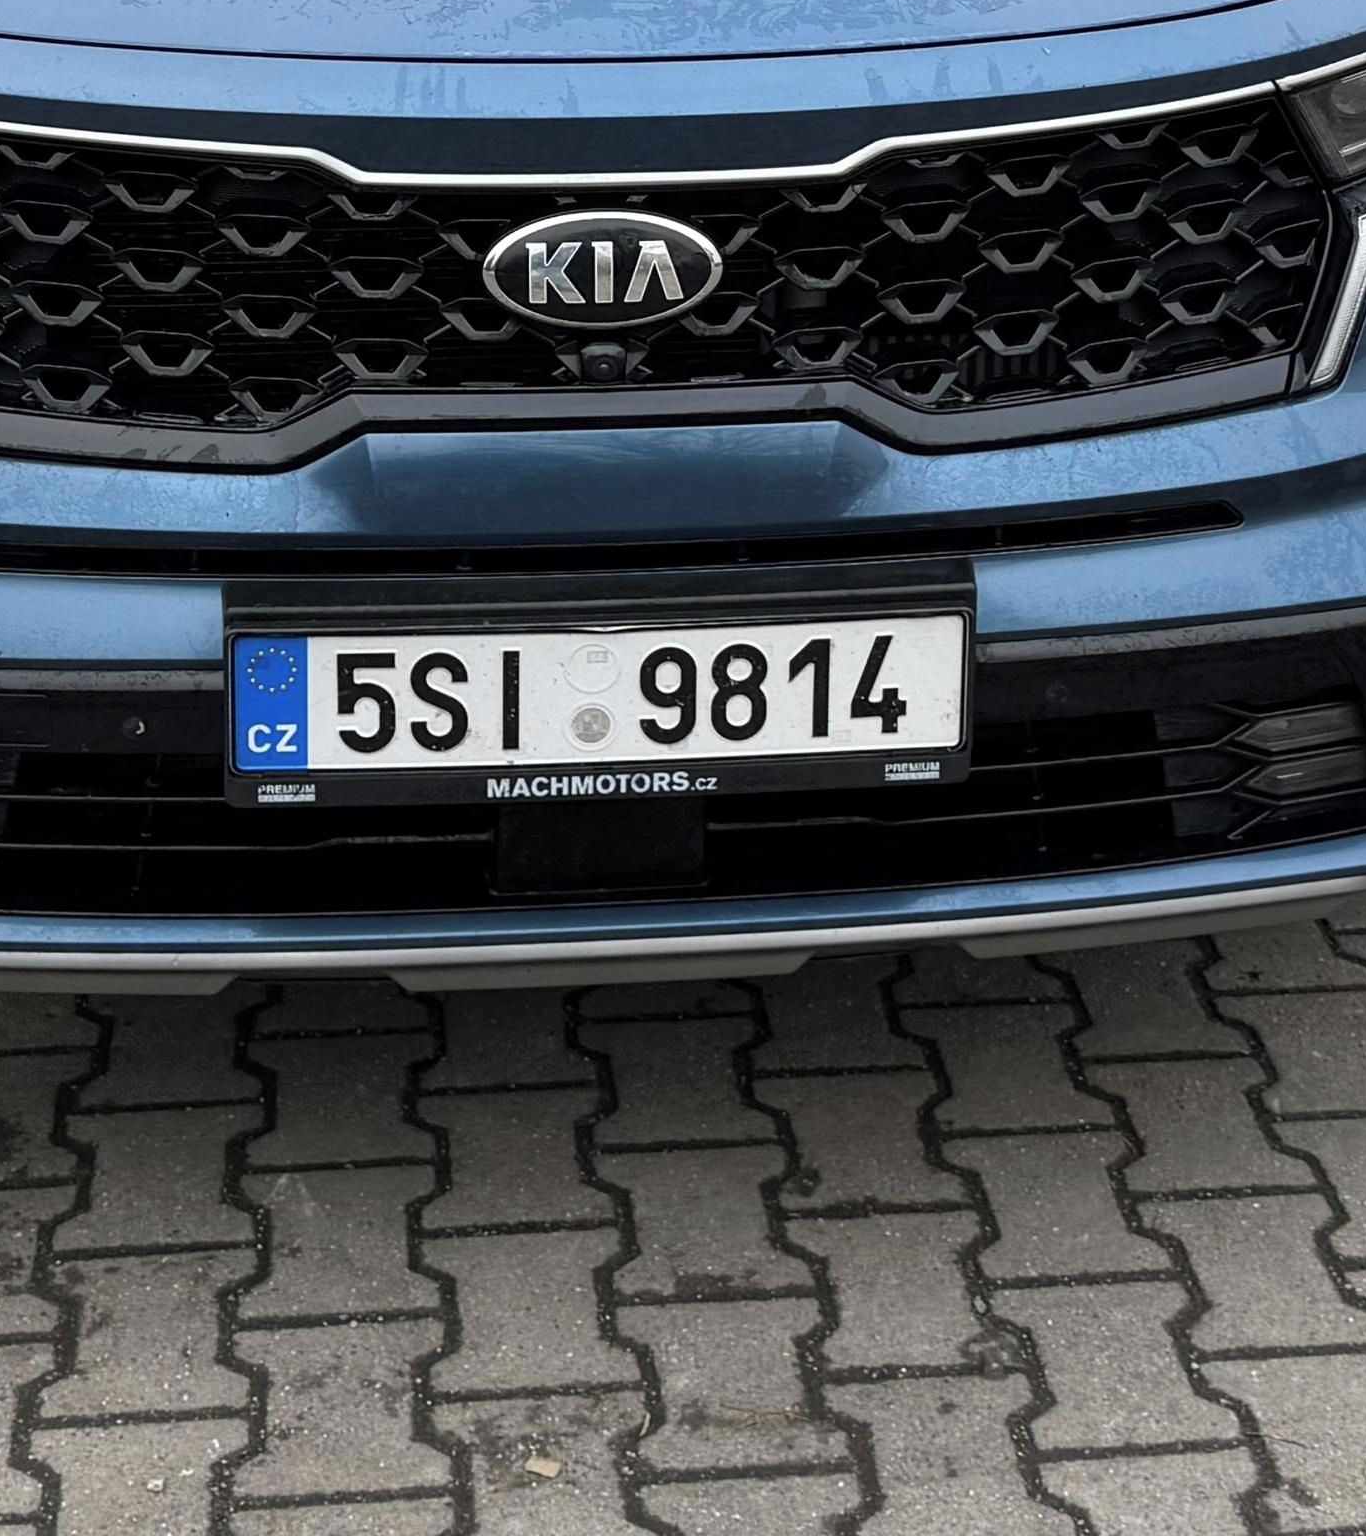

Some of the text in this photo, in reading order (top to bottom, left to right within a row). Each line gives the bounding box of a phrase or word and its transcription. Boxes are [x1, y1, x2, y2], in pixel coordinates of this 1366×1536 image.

[525, 240, 684, 304] KIA
[638, 634, 908, 746] 9814
[247, 724, 298, 754] CZ
